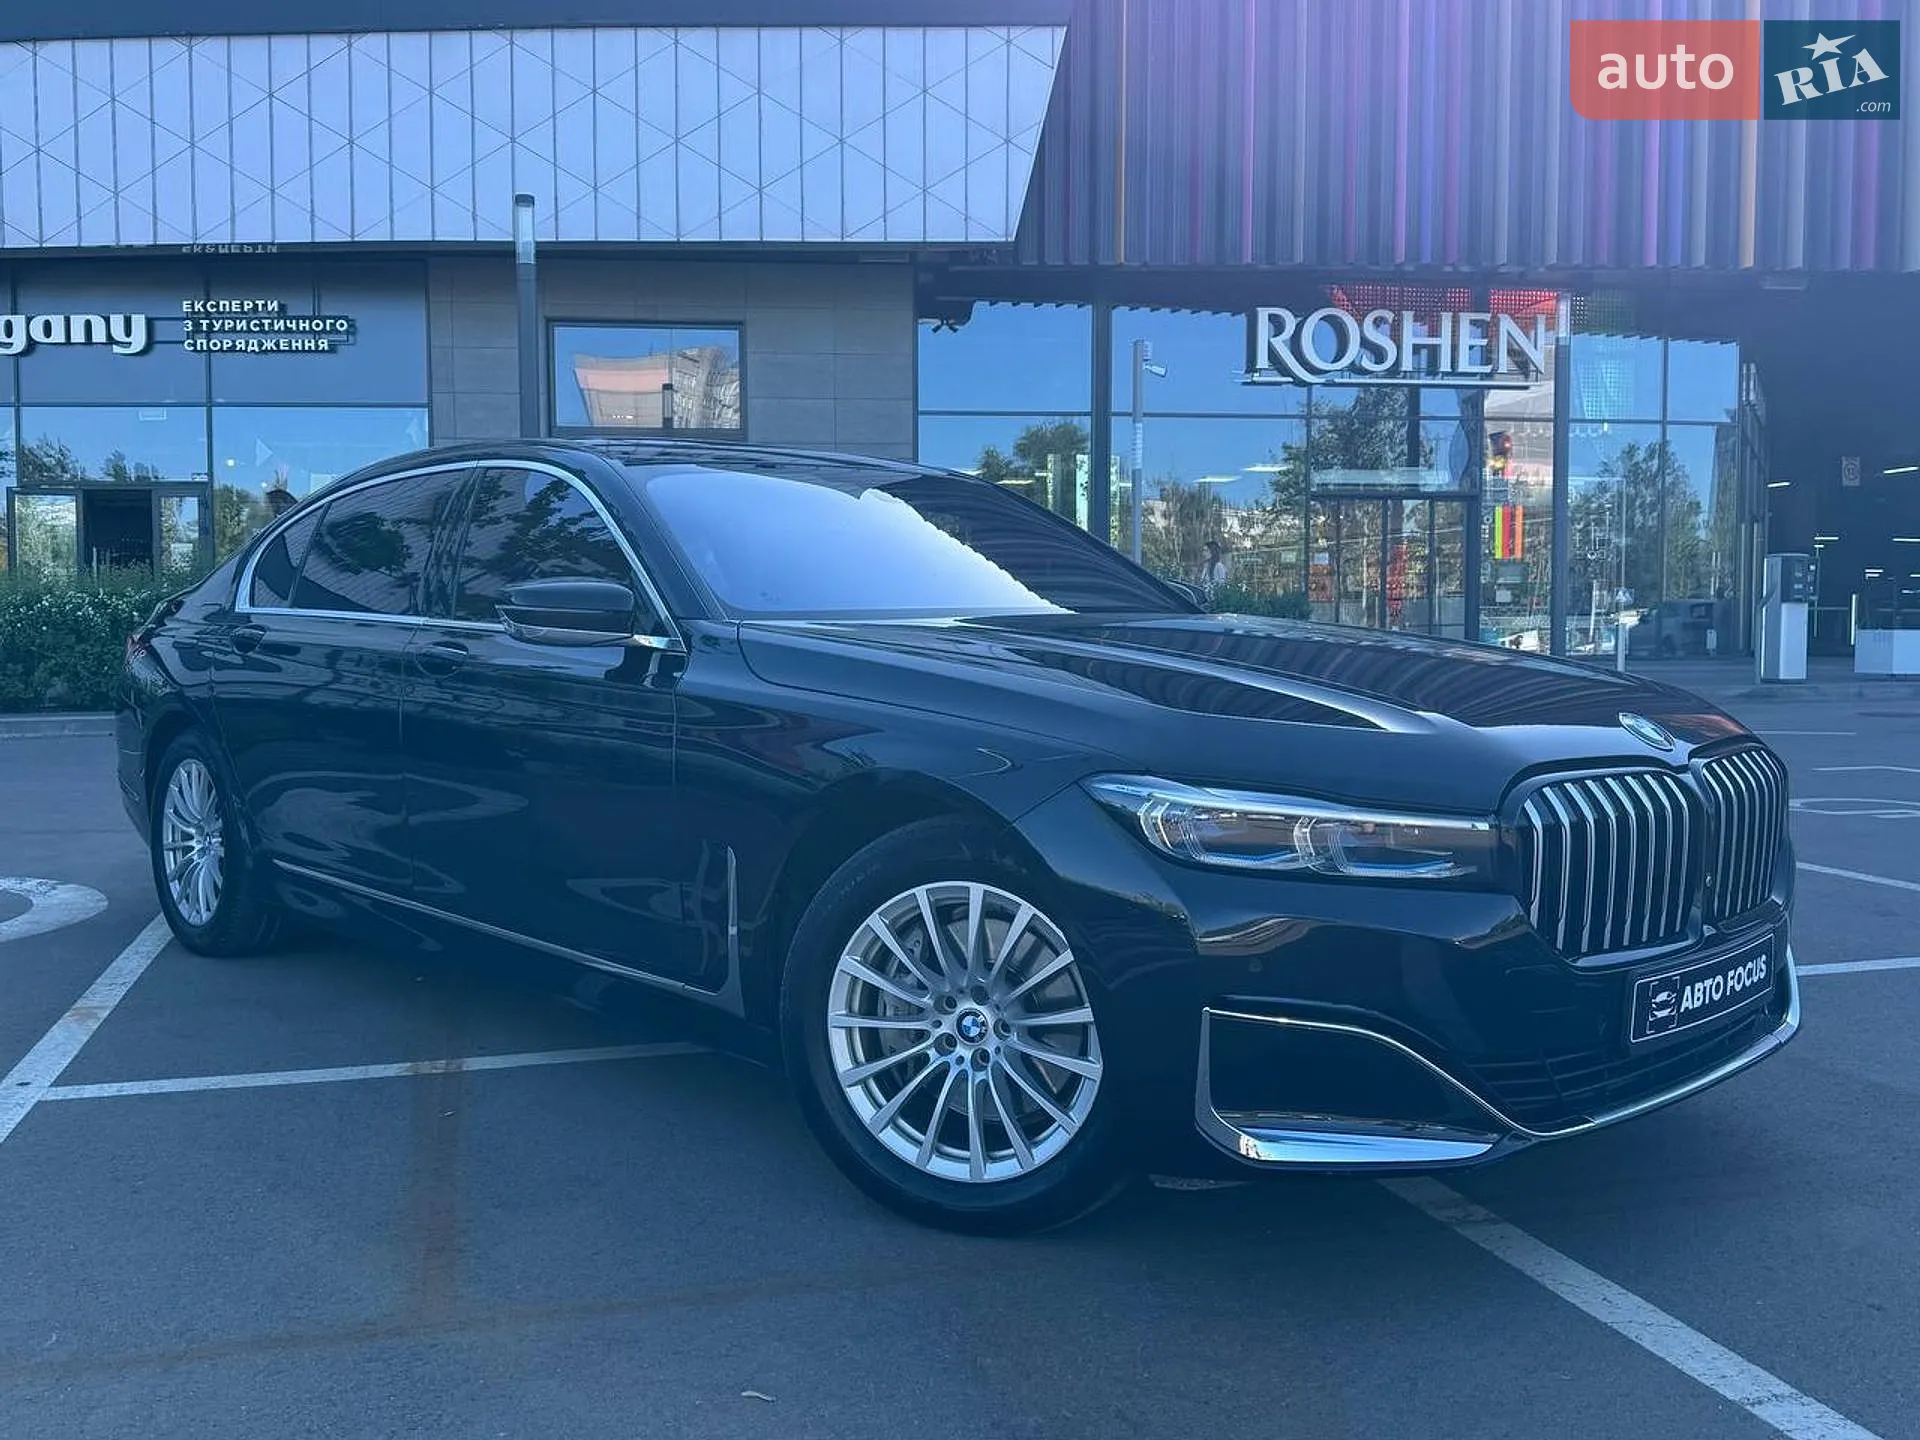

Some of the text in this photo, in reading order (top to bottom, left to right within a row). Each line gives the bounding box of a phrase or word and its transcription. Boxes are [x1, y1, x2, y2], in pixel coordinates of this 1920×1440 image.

[182, 300, 279, 312] ЕКСПЕРТИ
[0, 314, 147, 355] gany
[200, 319, 349, 332] ТУРИСТИЧНОГО
[183, 338, 329, 352] СПОРЯДЖЕННЯ
[1256, 307, 1545, 383] ROSHEN
[1726, 954, 1767, 996] FOCUS
